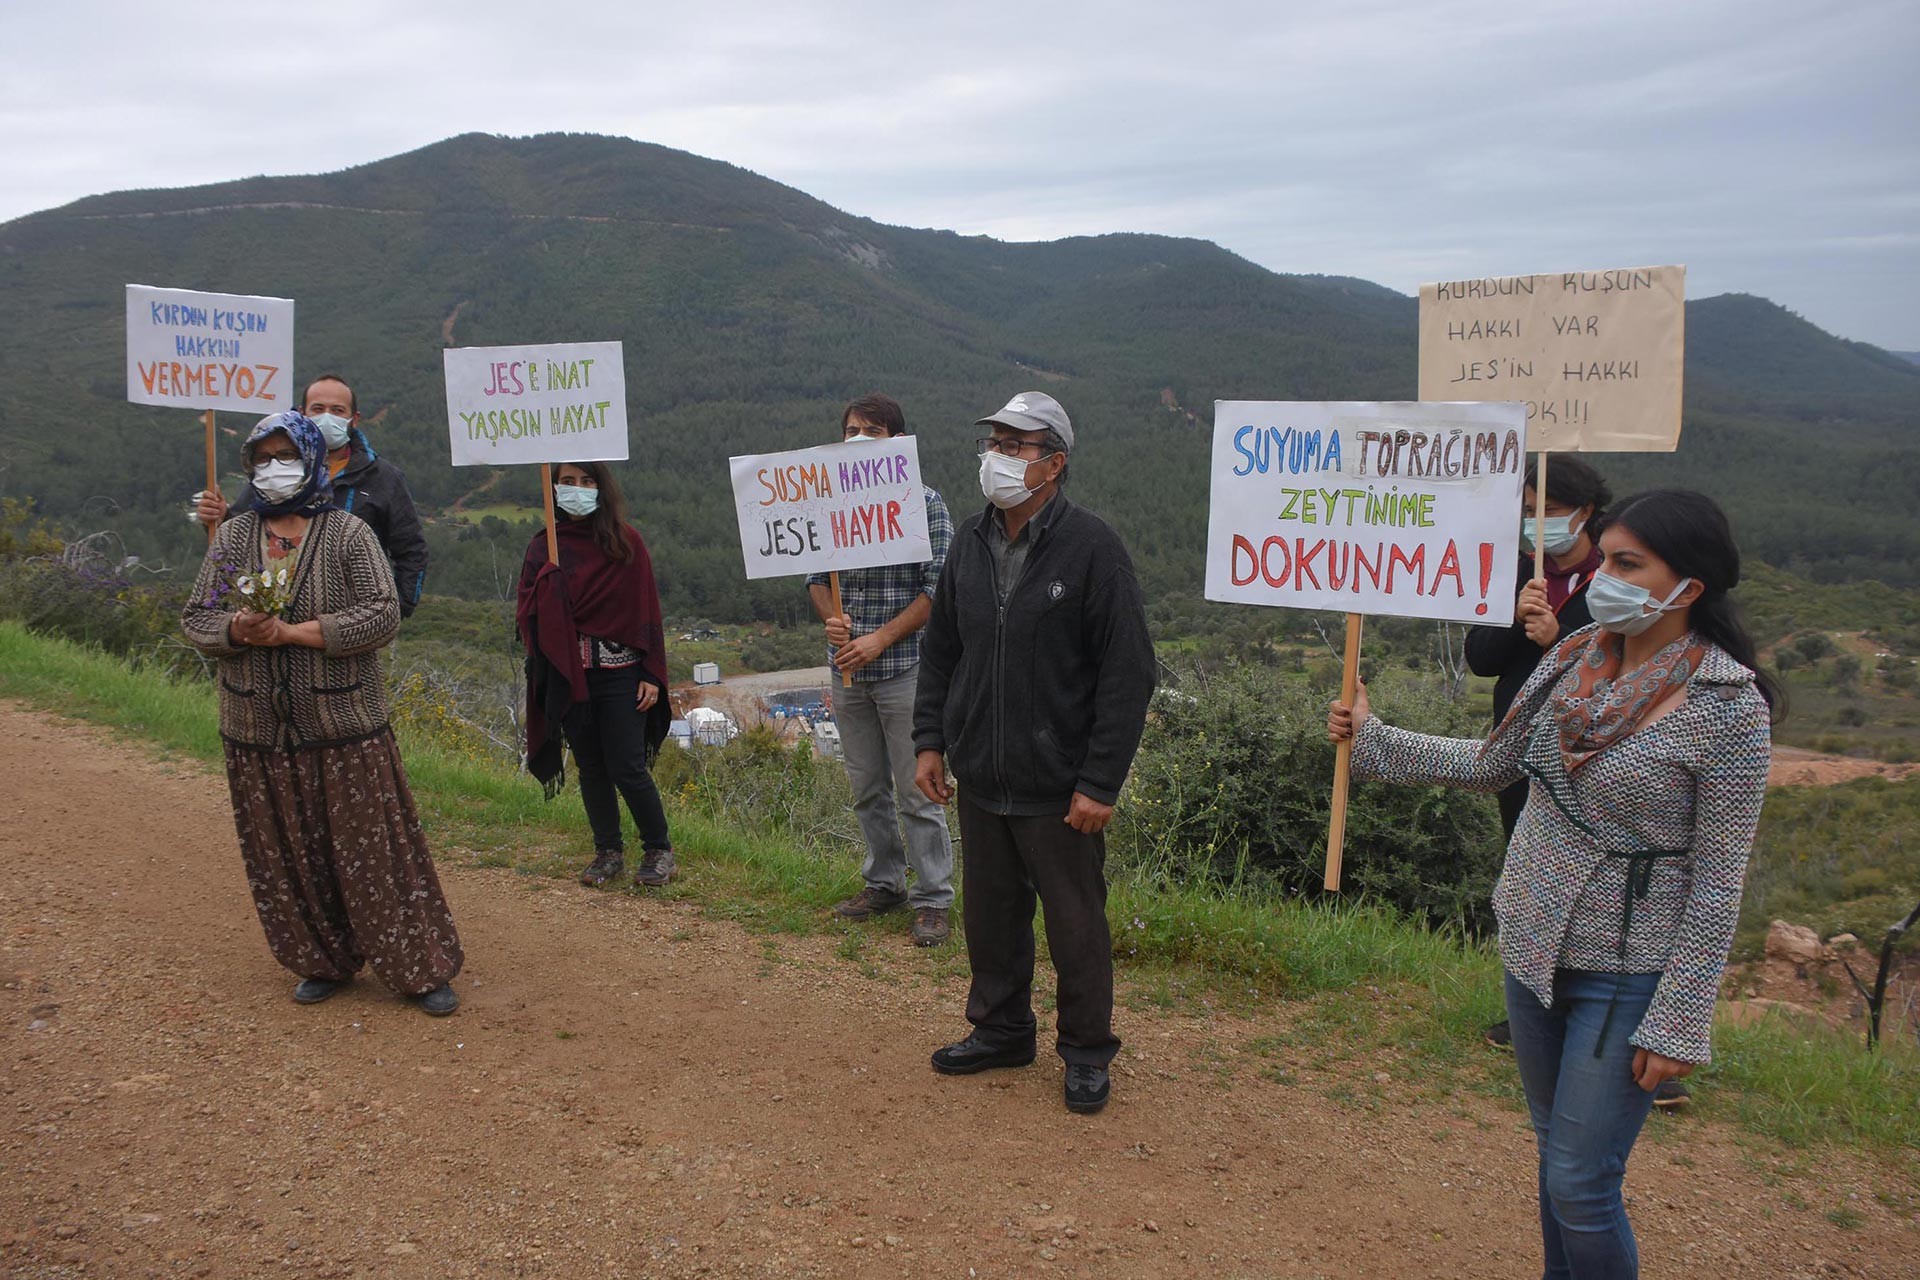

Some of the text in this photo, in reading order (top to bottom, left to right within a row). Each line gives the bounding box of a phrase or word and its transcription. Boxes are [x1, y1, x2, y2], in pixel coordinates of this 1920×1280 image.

[1563, 270, 1651, 294] KUŞUN
[213, 308, 268, 336] KUŞUN
[1448, 315, 1599, 341] HAKKI VAR
[175, 335, 241, 358] HAKKINI
[137, 361, 279, 400] VERMEYOZ
[546, 359, 595, 391] İNAT
[1562, 360, 1639, 382] HAKKI
[459, 401, 611, 447] YAŞASIN HAYAT
[1508, 399, 1589, 424] OK!!!
[1233, 425, 1519, 478] SUYUMA TOPRAĞIMA
[757, 454, 909, 506] SUSMA HAYKIR
[1278, 485, 1436, 528] ZEYTİNİME
[829, 500, 905, 549] HAYIR
[1231, 533, 1494, 616] DOKUNMA!
